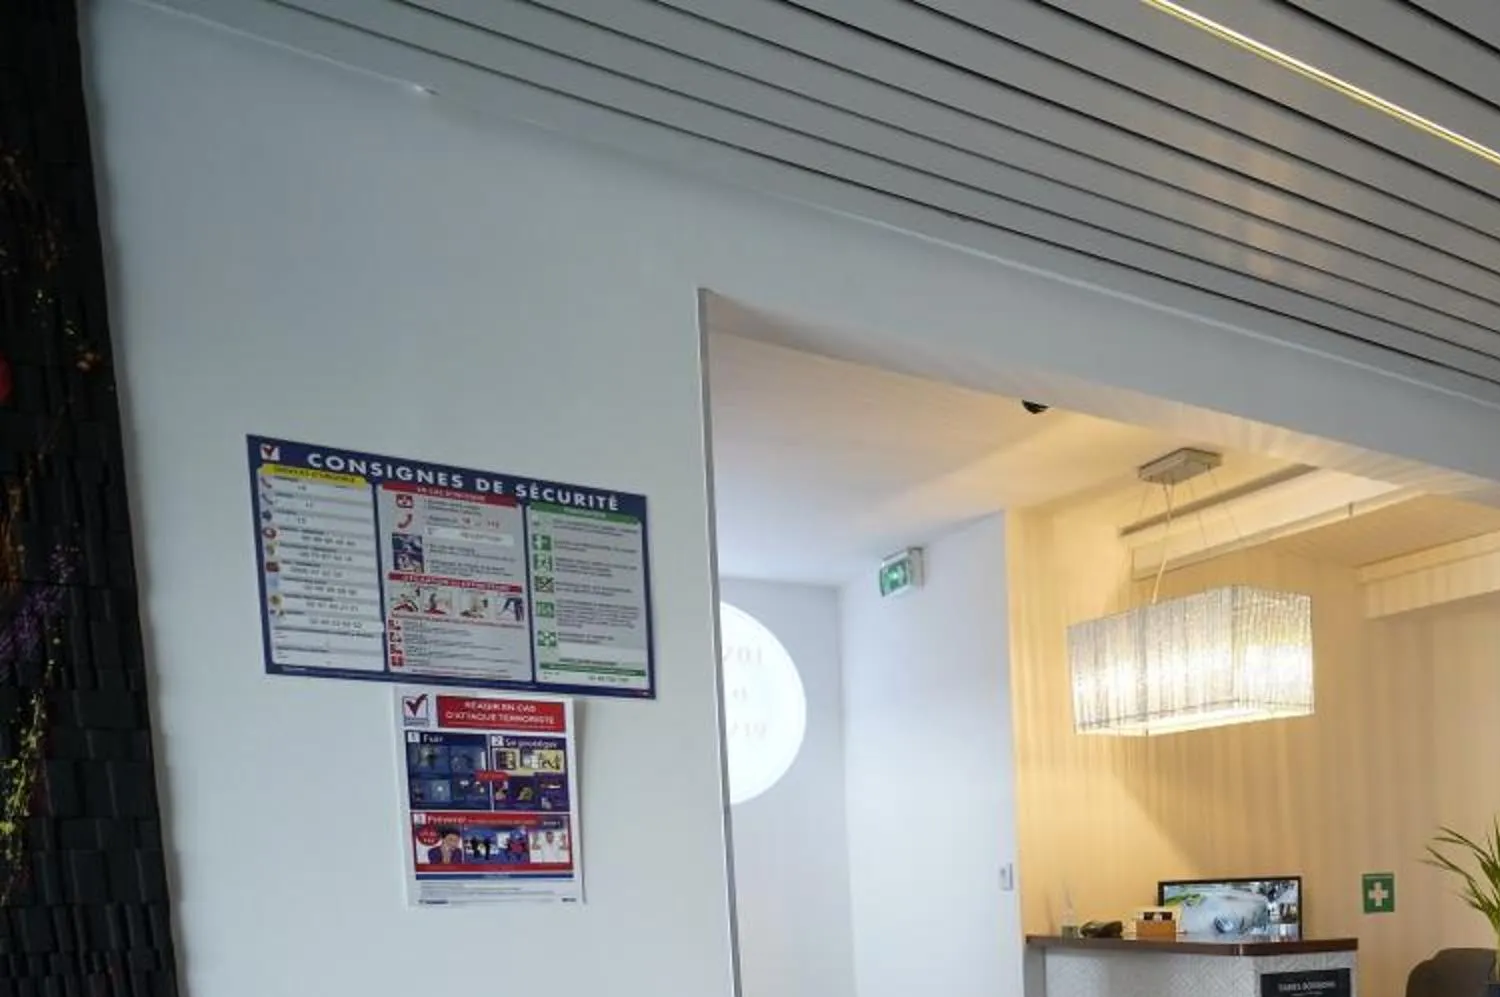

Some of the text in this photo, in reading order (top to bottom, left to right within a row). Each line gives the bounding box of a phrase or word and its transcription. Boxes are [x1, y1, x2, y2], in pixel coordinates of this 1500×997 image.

[306, 452, 464, 489] CONSIGNES
[475, 477, 504, 495] DE
[515, 482, 619, 511] SÉCURITÉ
